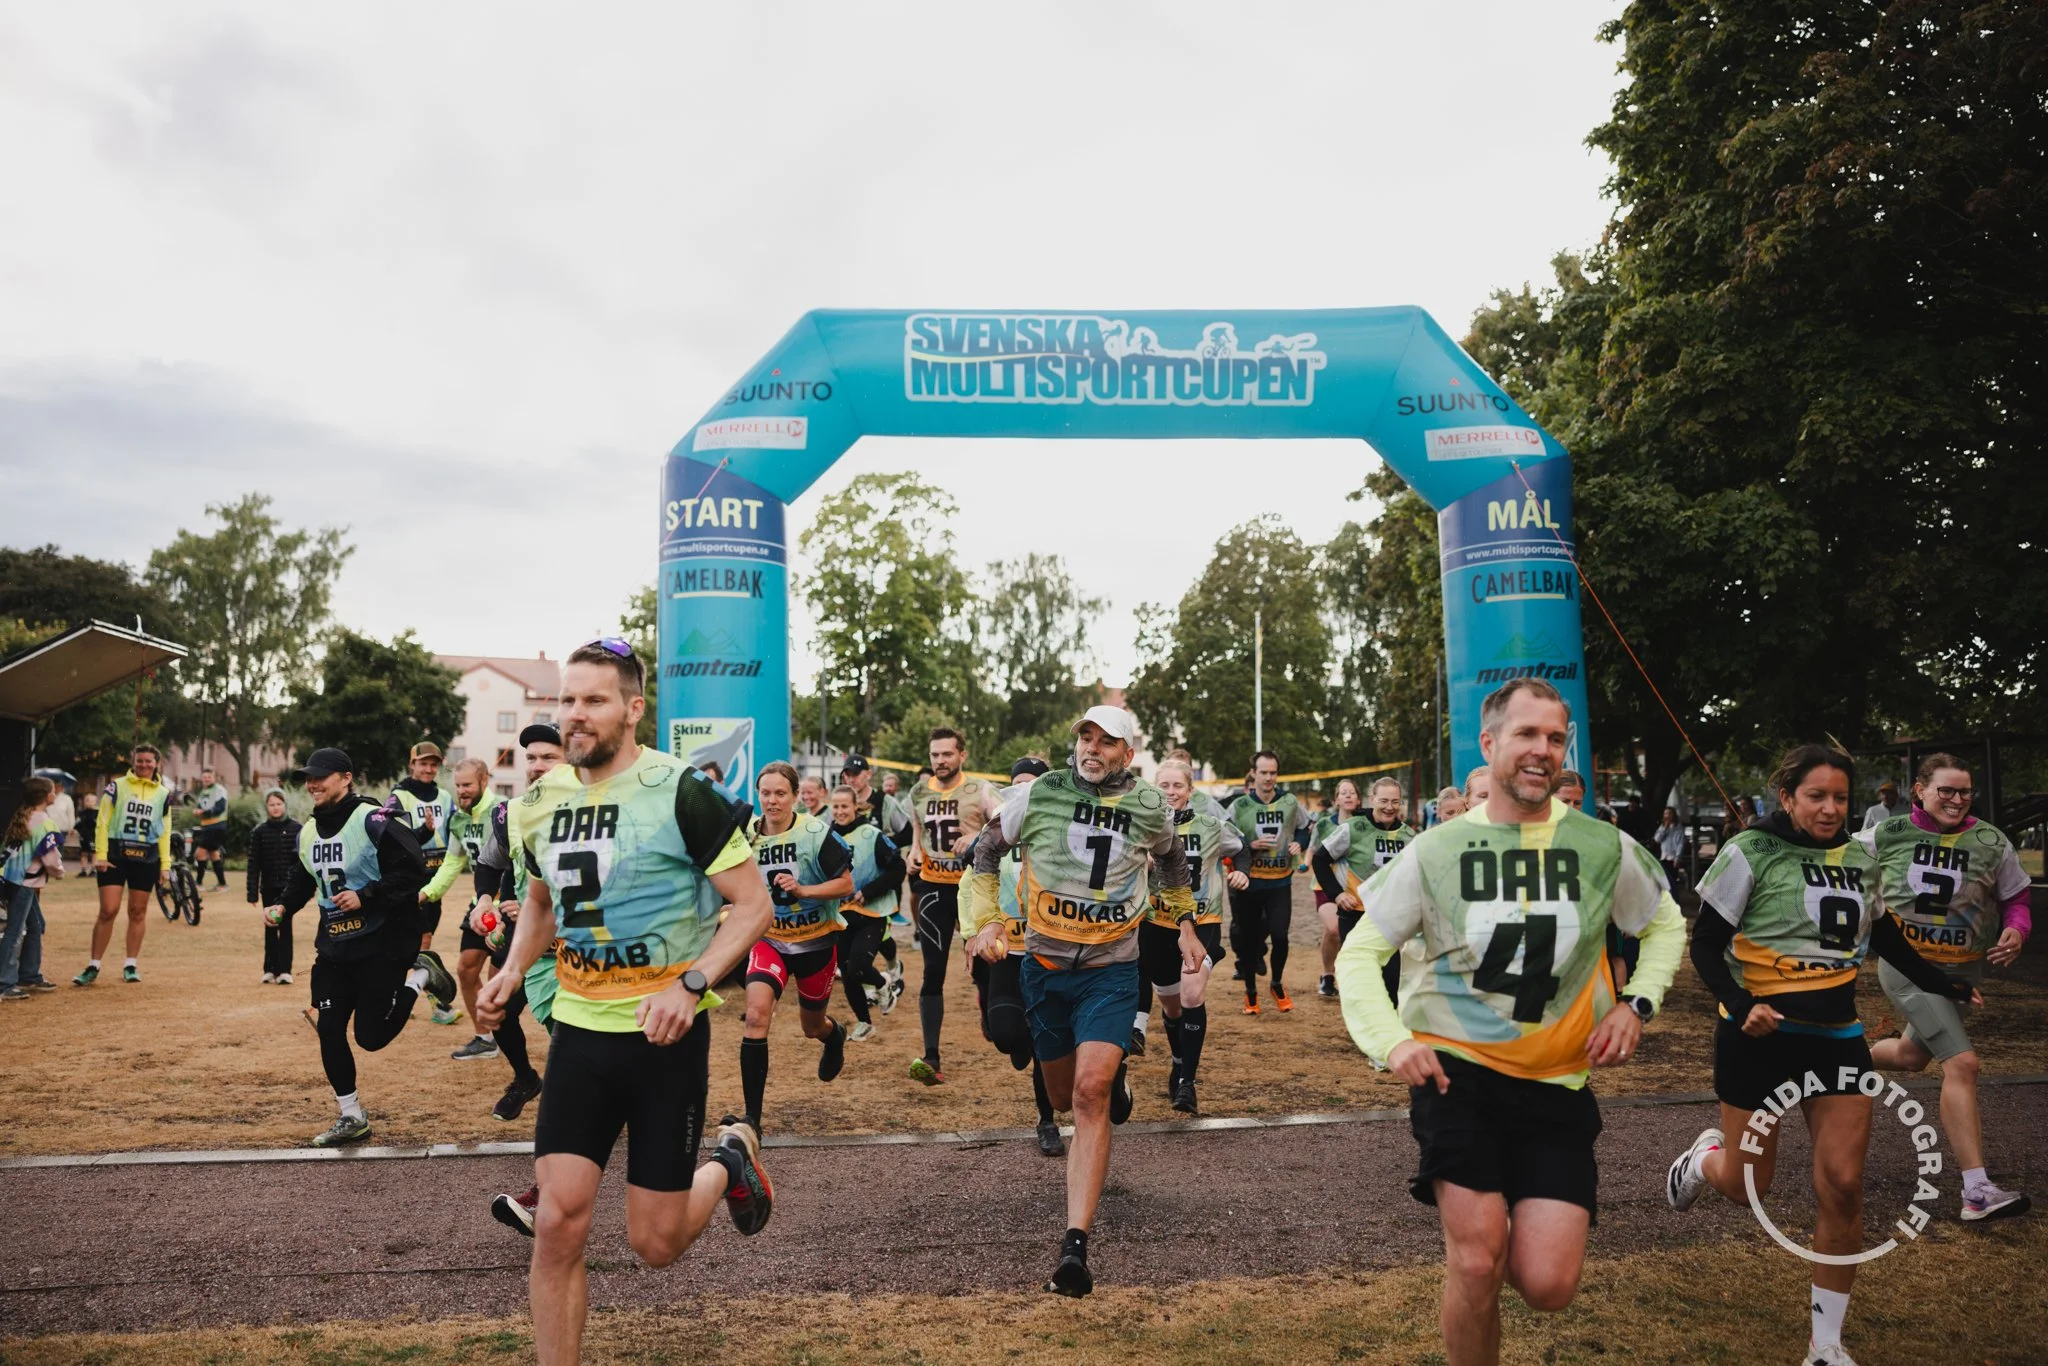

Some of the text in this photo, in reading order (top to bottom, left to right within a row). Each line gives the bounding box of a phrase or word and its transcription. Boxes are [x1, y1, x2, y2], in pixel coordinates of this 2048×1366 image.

[911, 317, 1103, 356] SVENSKA
[723, 382, 833, 407] SUUNTO
[911, 354, 1308, 402] MULTISPORTCUPEN
[1397, 393, 1509, 416] SUUNTO
[705, 422, 785, 437] MERRELL
[1437, 431, 1520, 446] MERRELL
[665, 496, 764, 531] START
[1487, 490, 1561, 532] MÅL
[663, 542, 769, 556] www.multisportcupen.se
[664, 567, 764, 600] CAMELBAK
[1471, 570, 1575, 604] CAMELBAK
[664, 659, 763, 679] montrail
[1475, 661, 1579, 684] montrail
[673, 723, 712, 736] Skinz
[549, 803, 619, 844] ÖAR
[926, 797, 959, 816] ÖAR
[1073, 799, 1133, 835] ÖAR
[1256, 809, 1285, 825] ÖAR
[123, 815, 152, 837] 29
[313, 841, 343, 864] ÖAR
[758, 843, 798, 866] ÖAR
[1086, 835, 1112, 891] 1
[1912, 839, 1970, 873] ÖAR
[315, 867, 347, 901] 12
[1460, 840, 1581, 902] ÖAR
[1801, 858, 1865, 894] ÖAR
[557, 850, 606, 929] 2
[1914, 871, 1956, 916] 2
[1047, 897, 1129, 924] JOKAB
[1819, 895, 1860, 949] 9
[1472, 914, 1561, 1024] 4
[685, 1114, 694, 1153] CRAFT
